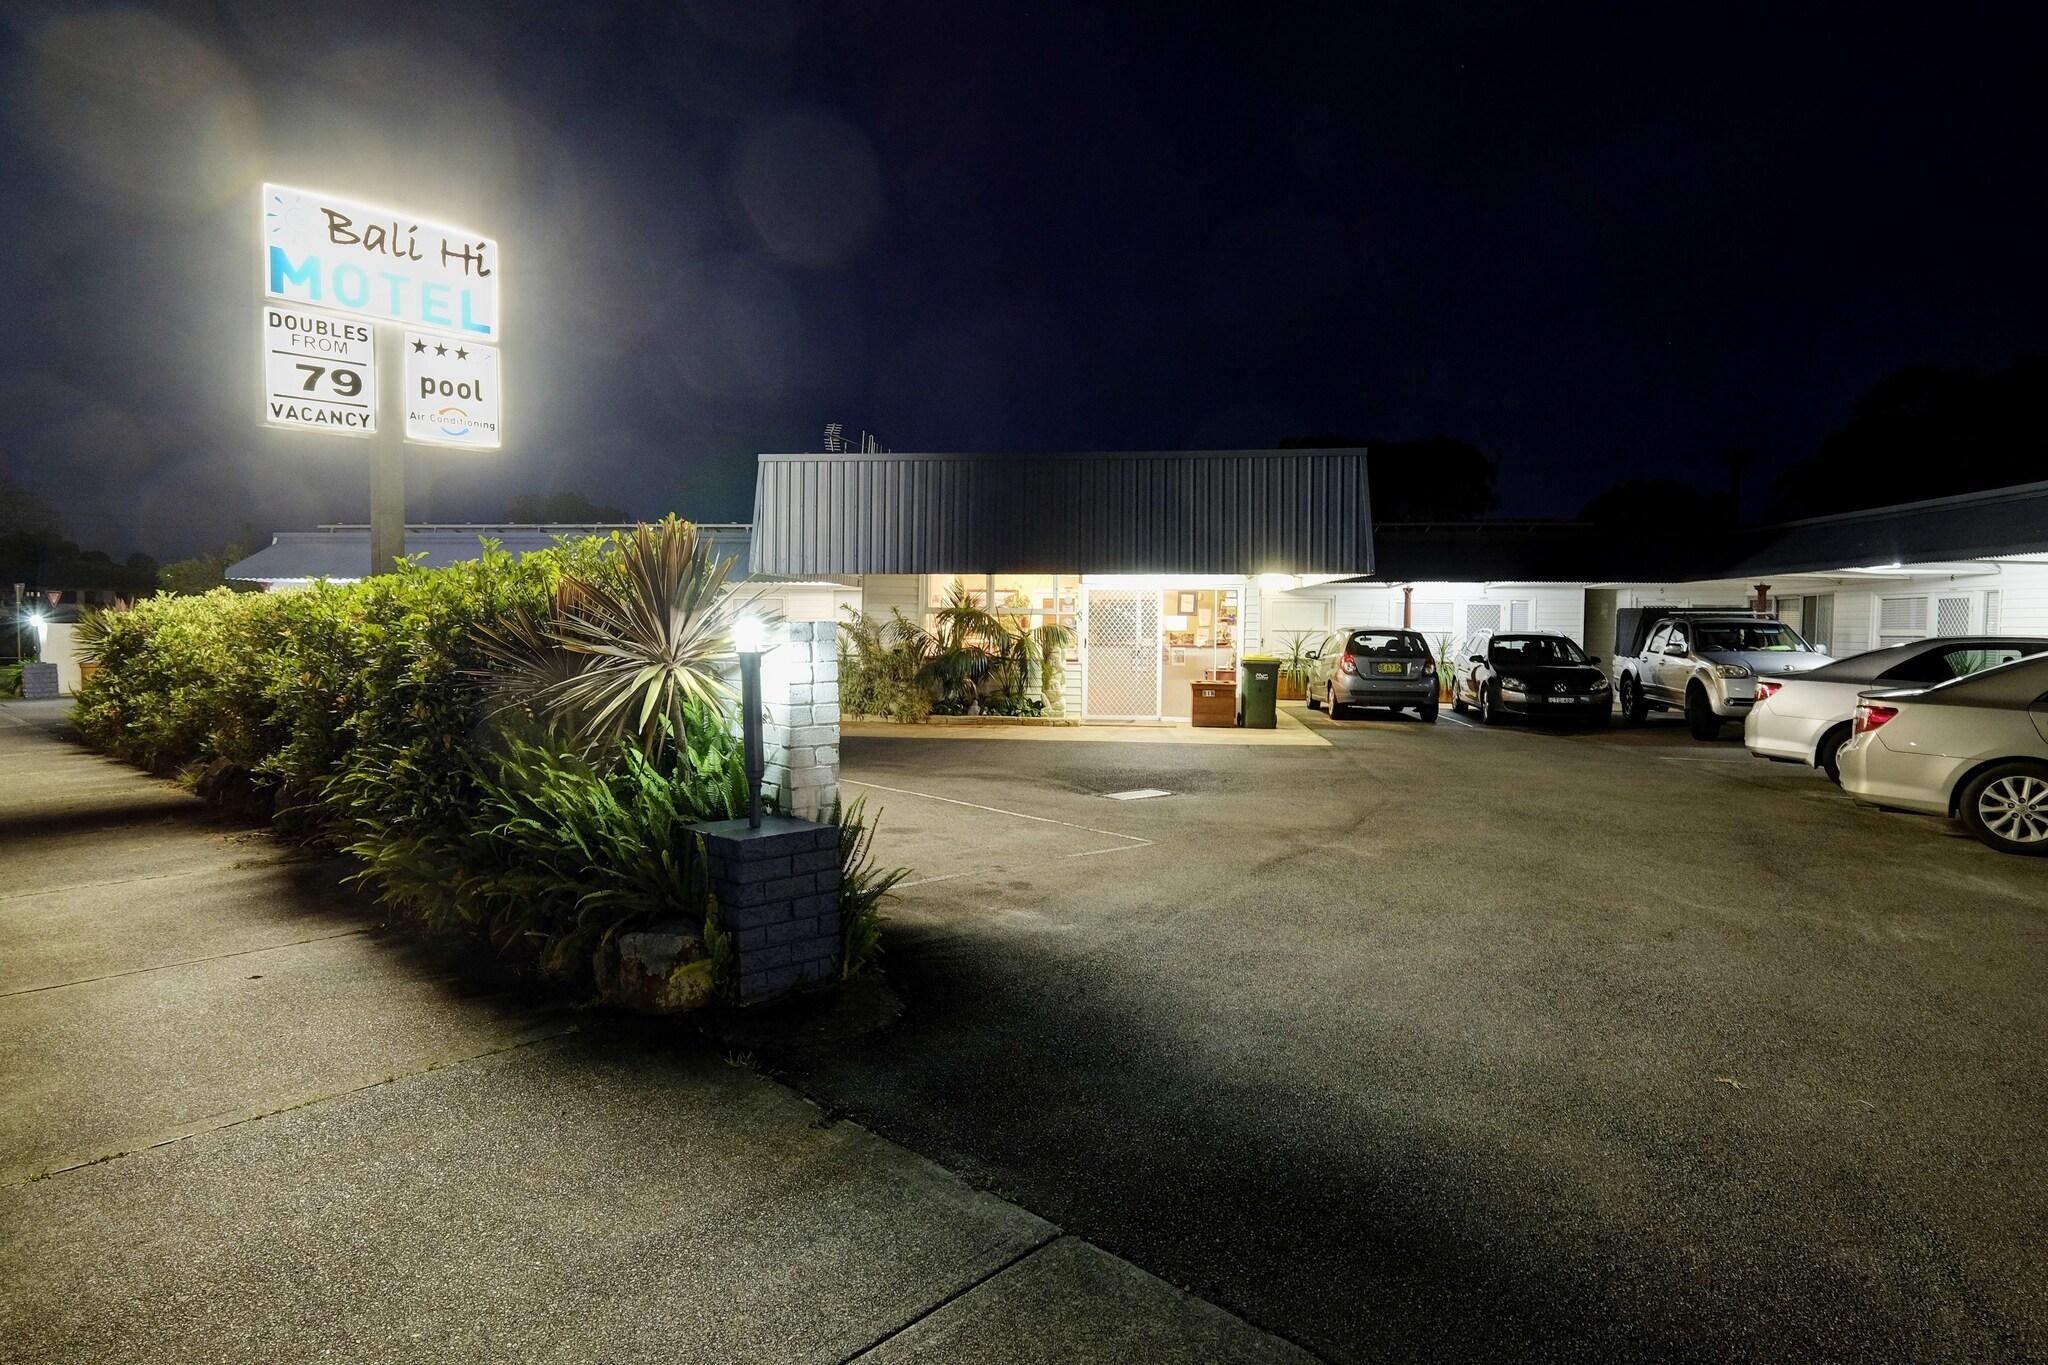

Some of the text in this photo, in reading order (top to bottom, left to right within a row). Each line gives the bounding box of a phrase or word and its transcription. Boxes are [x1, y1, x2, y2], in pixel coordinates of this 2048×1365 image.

[320, 207, 491, 277] Bali Hi
[270, 245, 491, 335] MOTEL
[269, 311, 369, 342] DOUBLES
[291, 333, 348, 354] FROM
[295, 363, 363, 397] 79
[420, 376, 483, 402] pool
[270, 402, 370, 428] VACANCY
[409, 411, 496, 431] Air Conditioning
